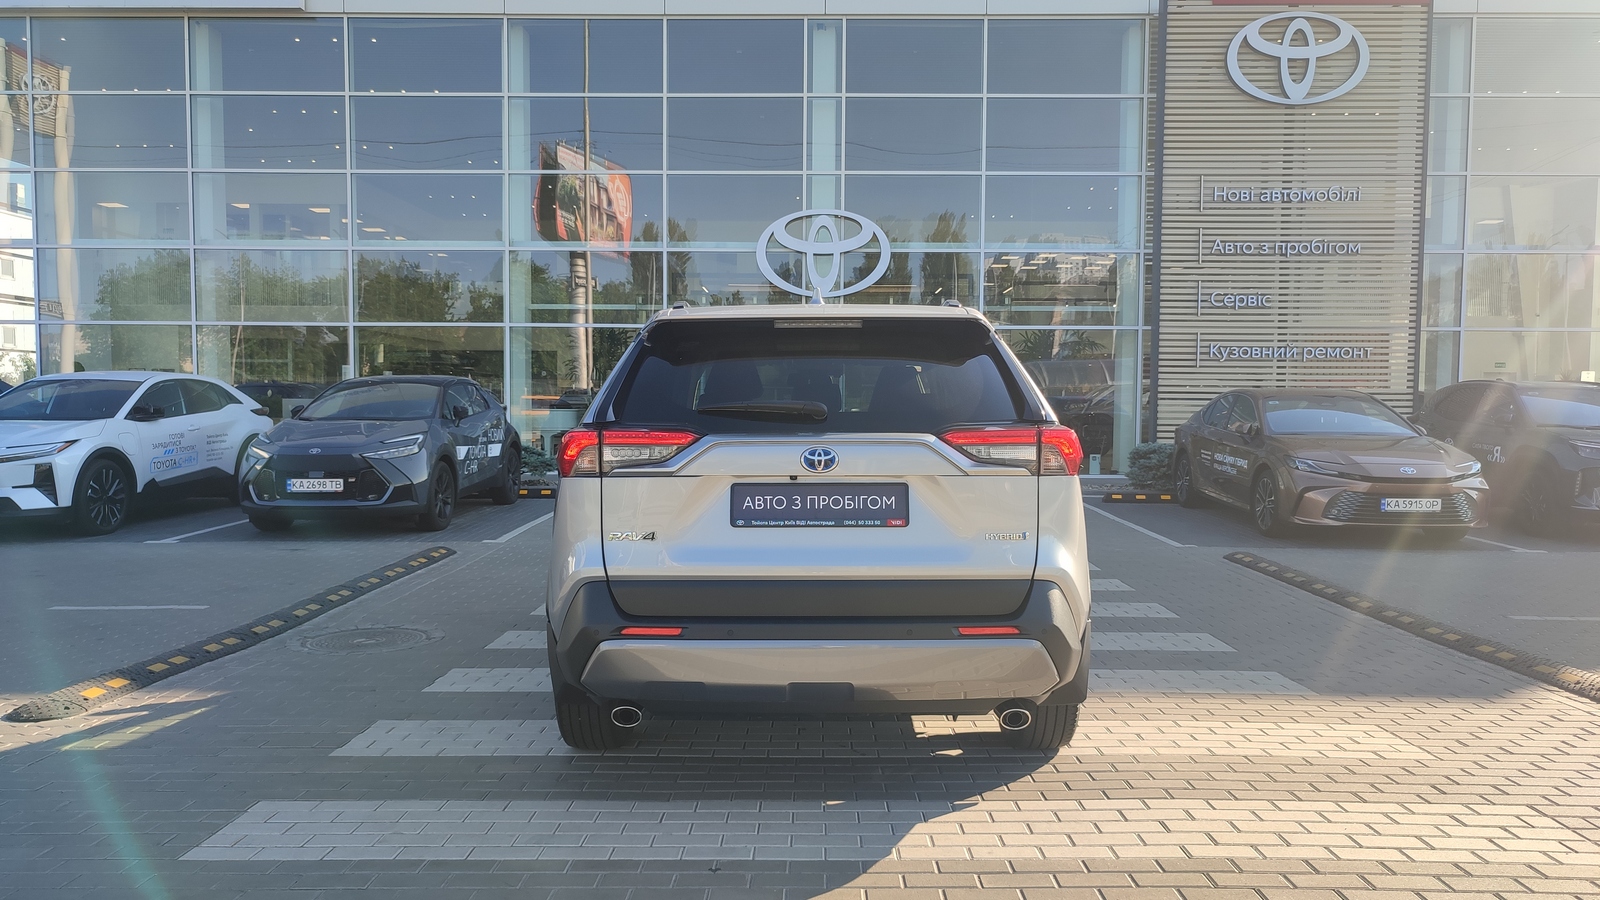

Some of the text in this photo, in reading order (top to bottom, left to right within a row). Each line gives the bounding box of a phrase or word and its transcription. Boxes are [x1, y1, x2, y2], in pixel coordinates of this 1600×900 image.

[1213, 186, 1362, 202] Нові автомобілі
[1211, 238, 1361, 258] Авто з пробігом
[1210, 291, 1272, 310] Сервіс
[1209, 343, 1373, 362] Кузовний ремонт
[152, 458, 177, 471] TOYOTA
[292, 480, 342, 490] KA 2698 TB
[742, 495, 896, 510] АВТО З ПРОБІГОМ
[1386, 499, 1439, 509] KA 5915 OP
[608, 531, 657, 541] RAV4
[985, 533, 1024, 541] HYBRID
